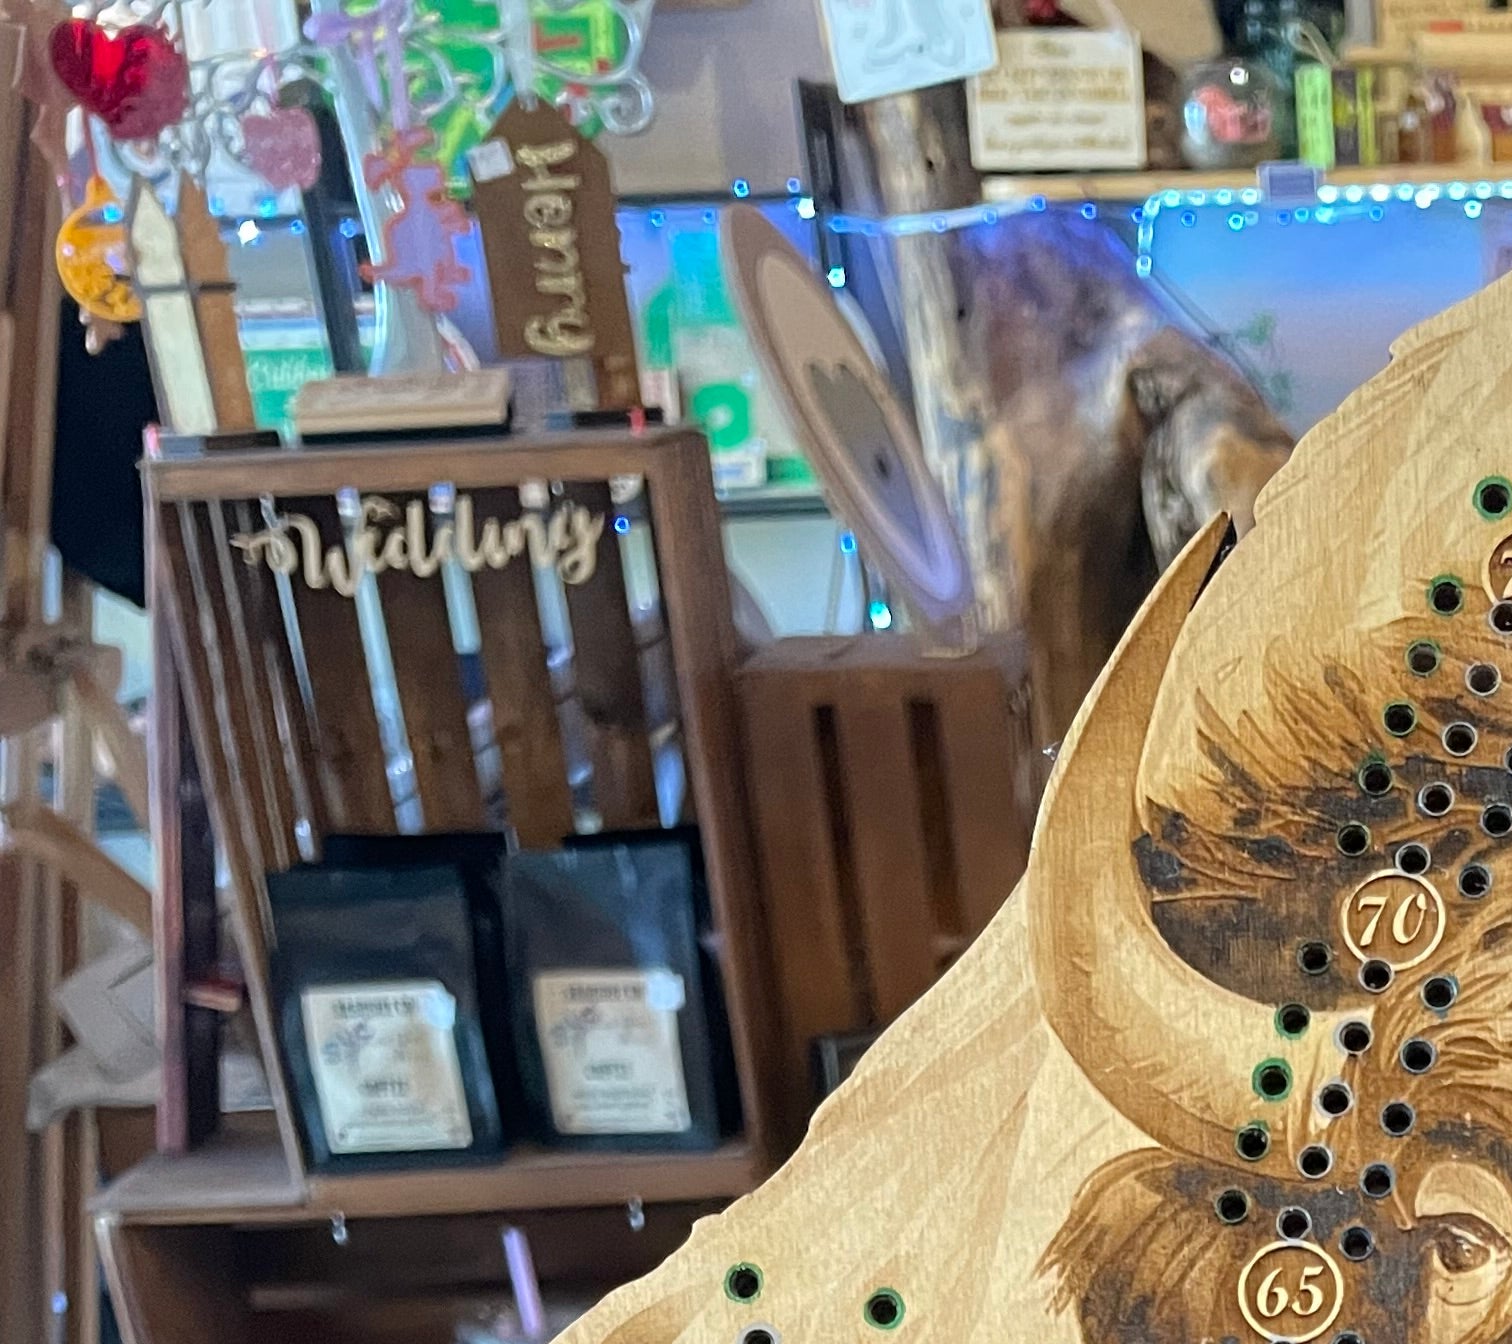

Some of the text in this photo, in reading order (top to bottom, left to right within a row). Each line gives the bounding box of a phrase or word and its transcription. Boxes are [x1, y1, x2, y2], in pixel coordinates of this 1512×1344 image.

[516, 139, 595, 357] Henry
[1358, 894, 1426, 946] 70
[1257, 1266, 1323, 1317] 65
